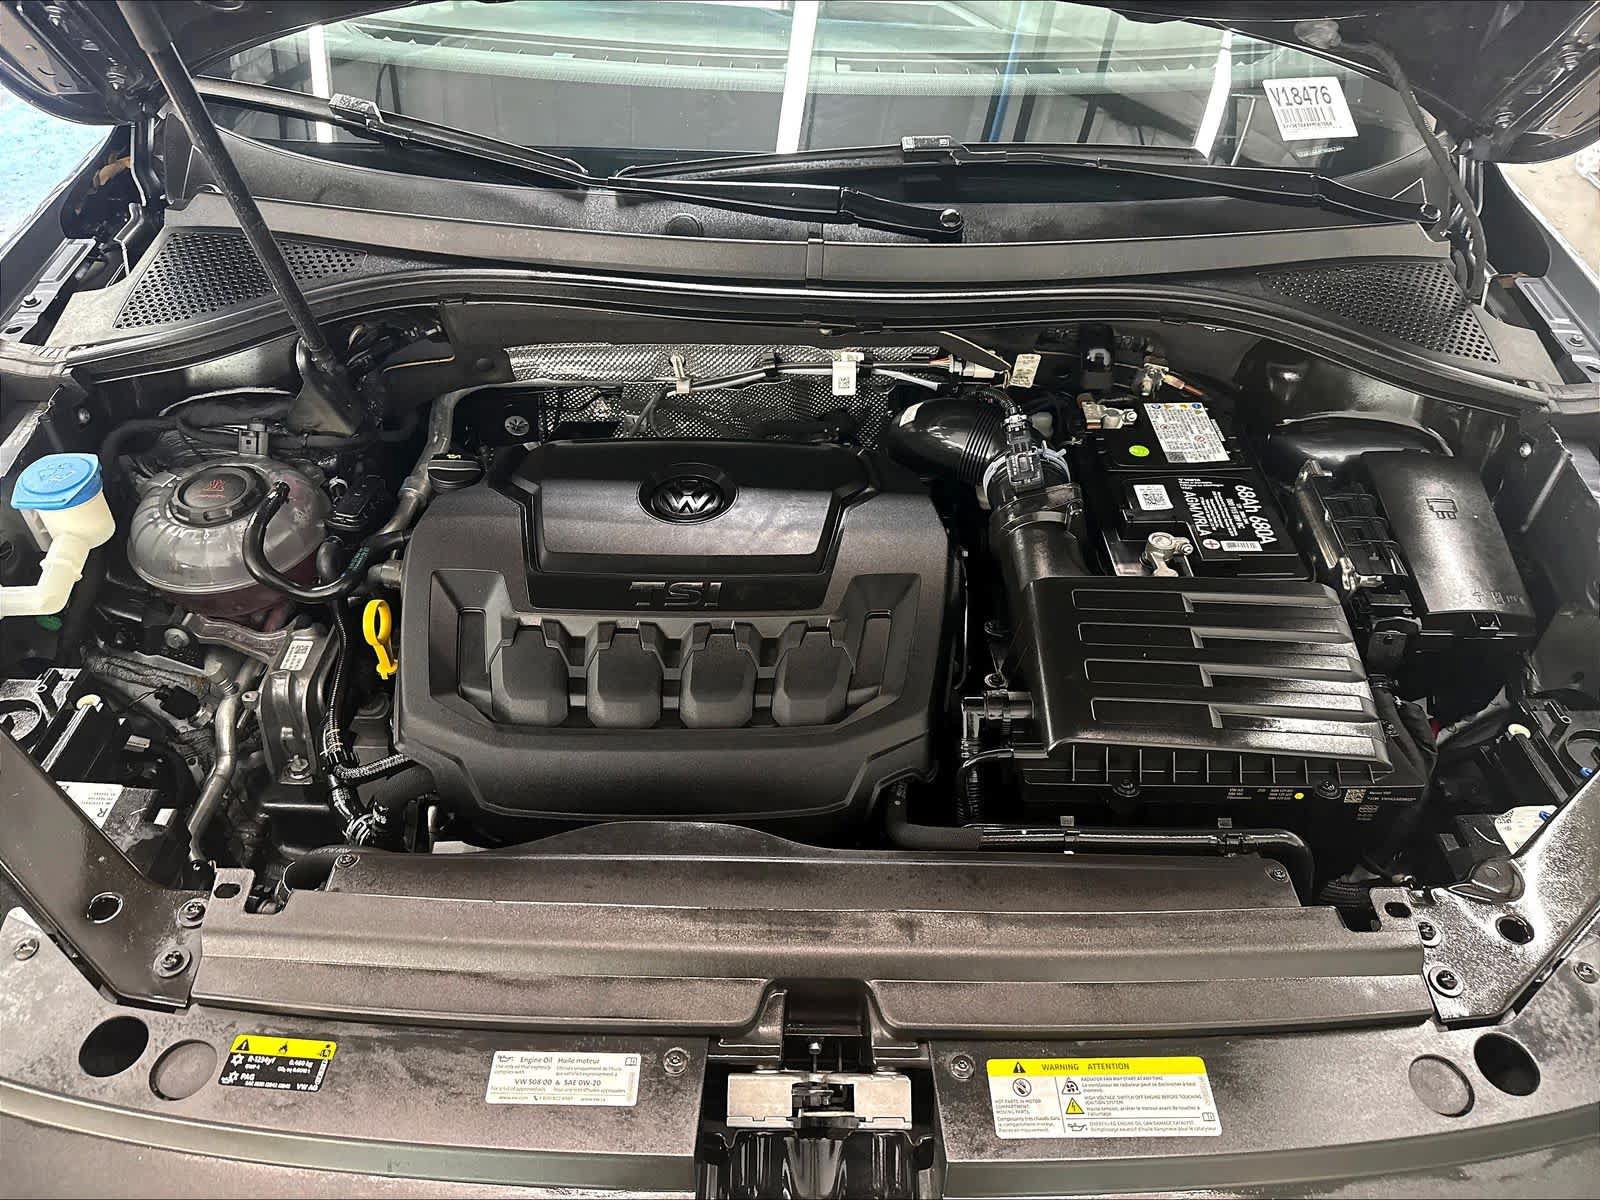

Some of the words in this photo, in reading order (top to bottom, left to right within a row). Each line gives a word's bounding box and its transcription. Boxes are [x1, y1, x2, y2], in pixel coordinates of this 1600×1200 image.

[1269, 86, 1332, 107] V18476
[1183, 491, 1213, 536] AGM/VRLA
[1235, 484, 1262, 513] 68Ah
[1249, 516, 1278, 544] 680A
[628, 581, 723, 607] TSI
[520, 1056, 542, 1065] Engine
[543, 1056, 553, 1064] Oil
[558, 1056, 575, 1064] Huile
[576, 1057, 600, 1065] moteur
[1041, 1063, 1079, 1071] WARNING
[1087, 1062, 1130, 1070] ATTENTION
